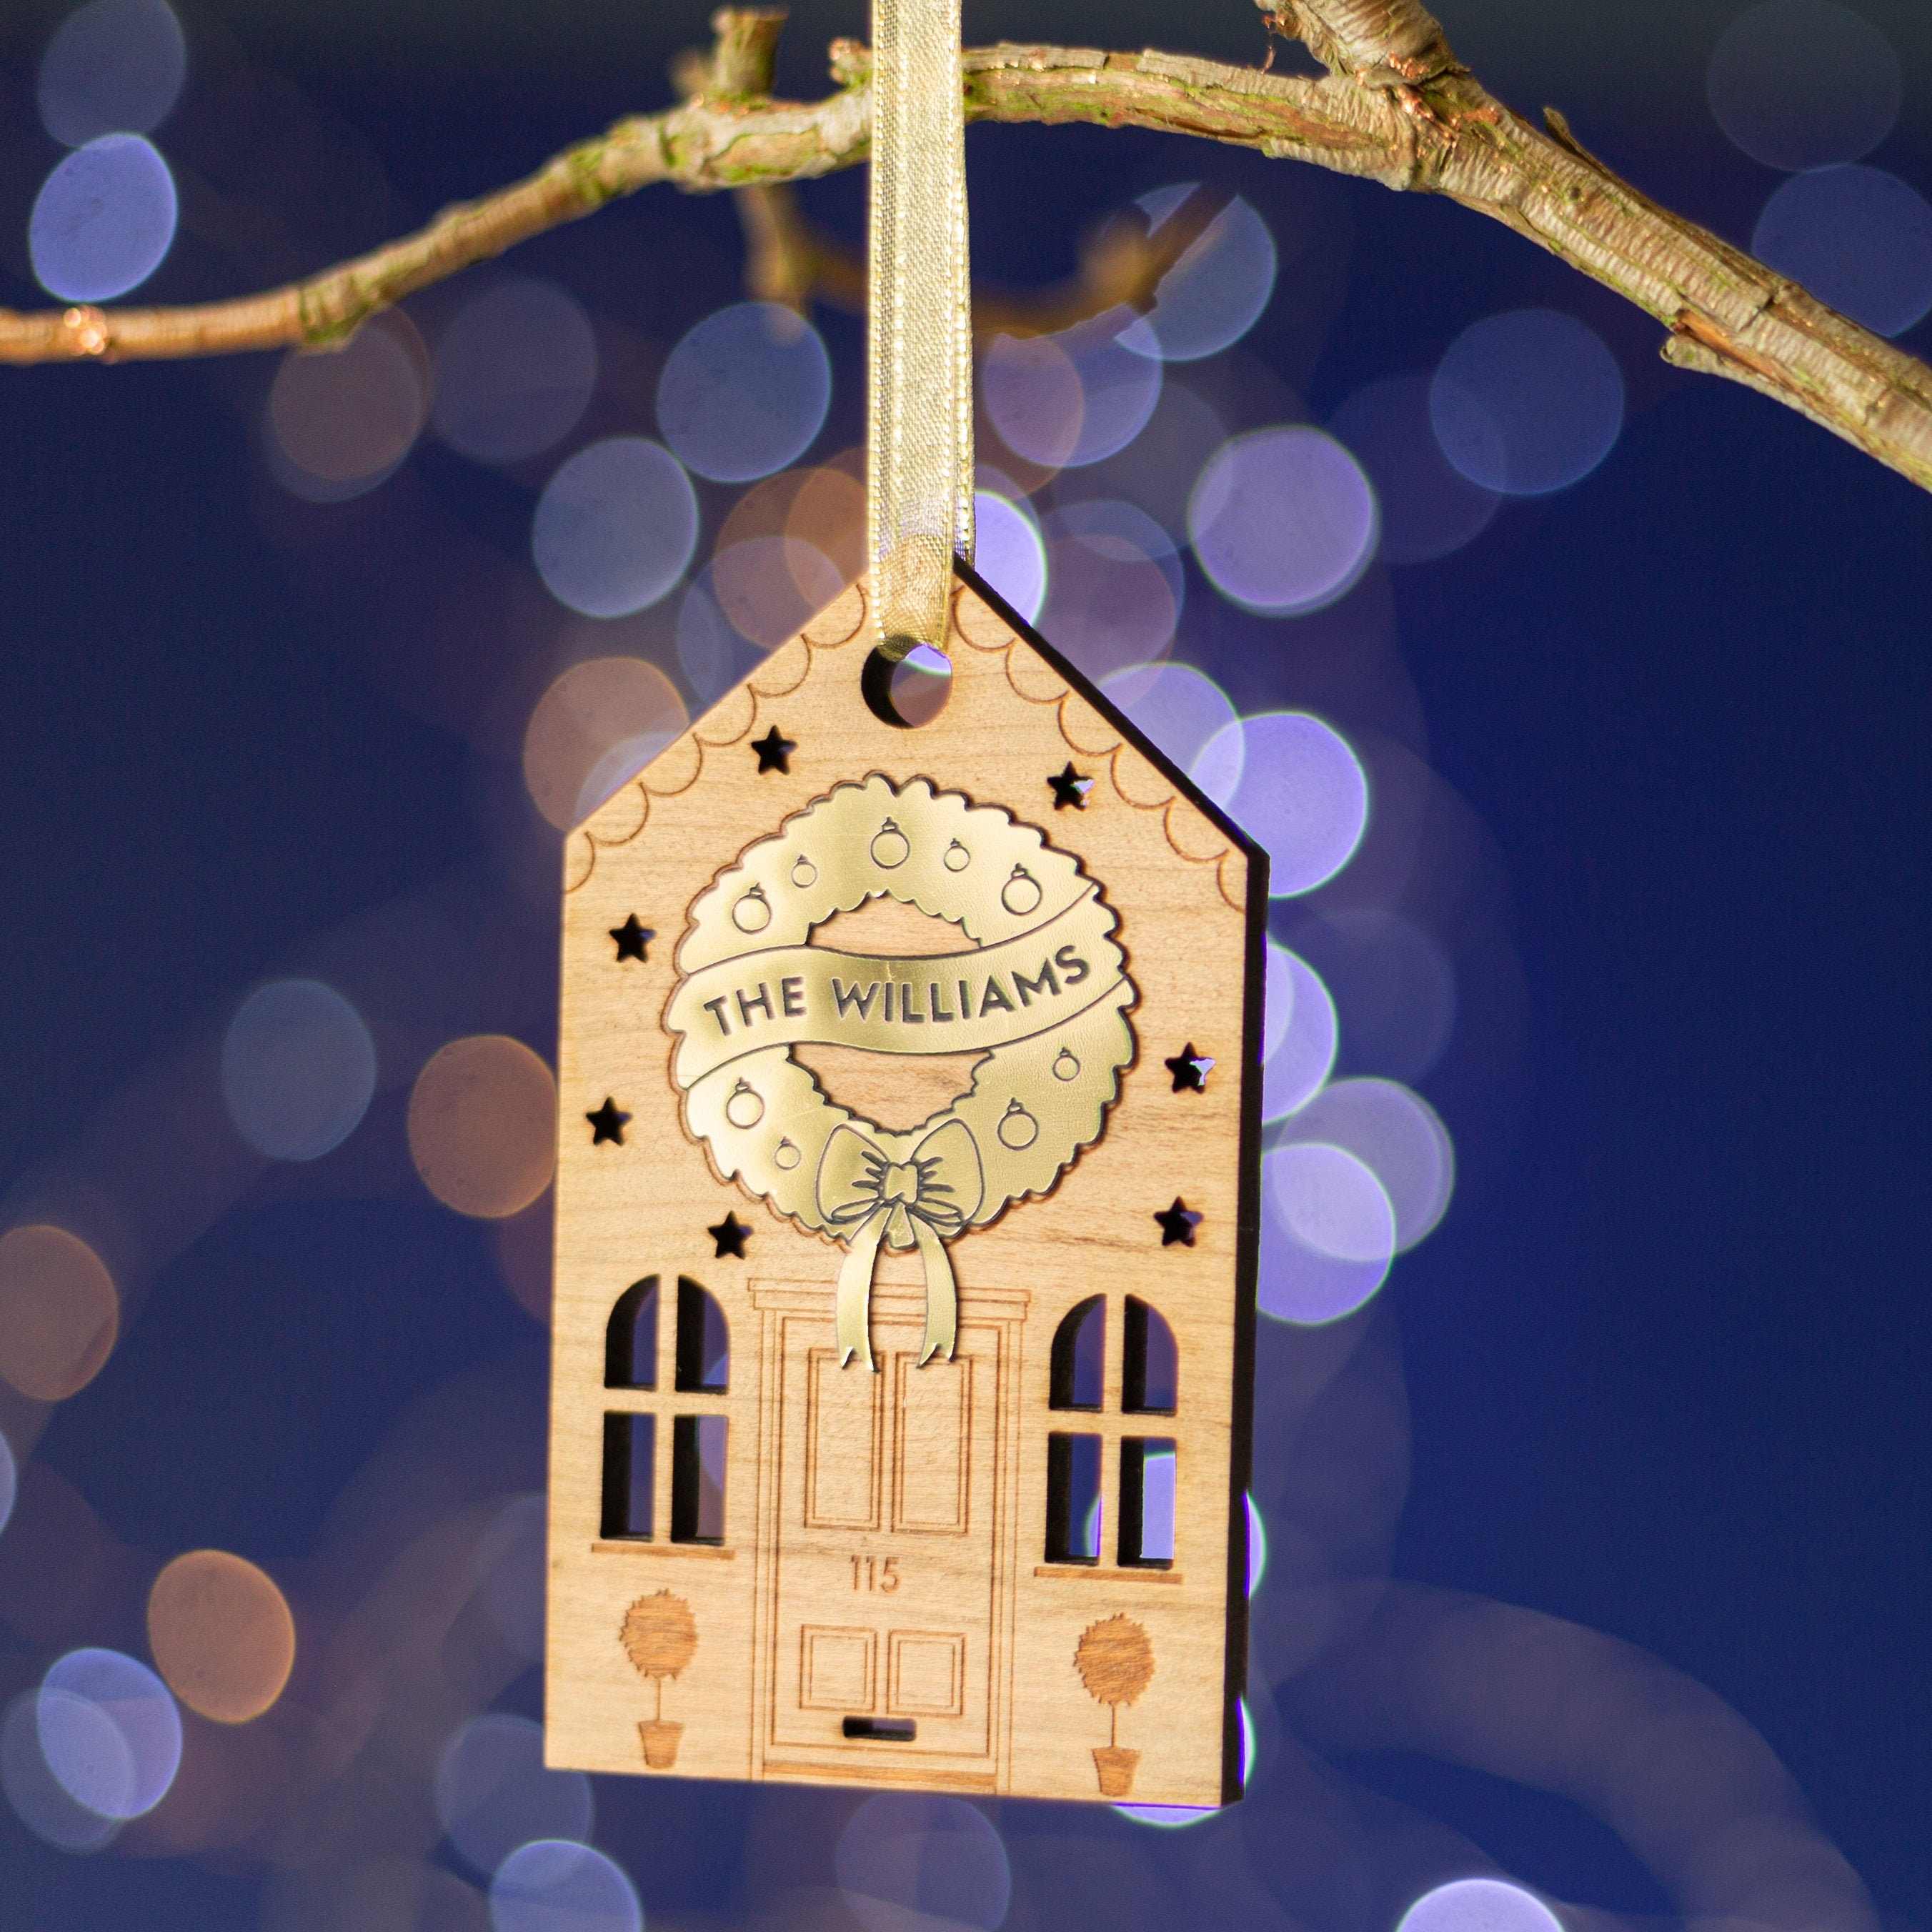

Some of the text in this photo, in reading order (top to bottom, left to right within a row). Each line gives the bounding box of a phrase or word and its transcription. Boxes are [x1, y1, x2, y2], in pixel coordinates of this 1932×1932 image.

[703, 945, 1090, 1036] THE WILLIAMS
[850, 1555, 901, 1593] 115
